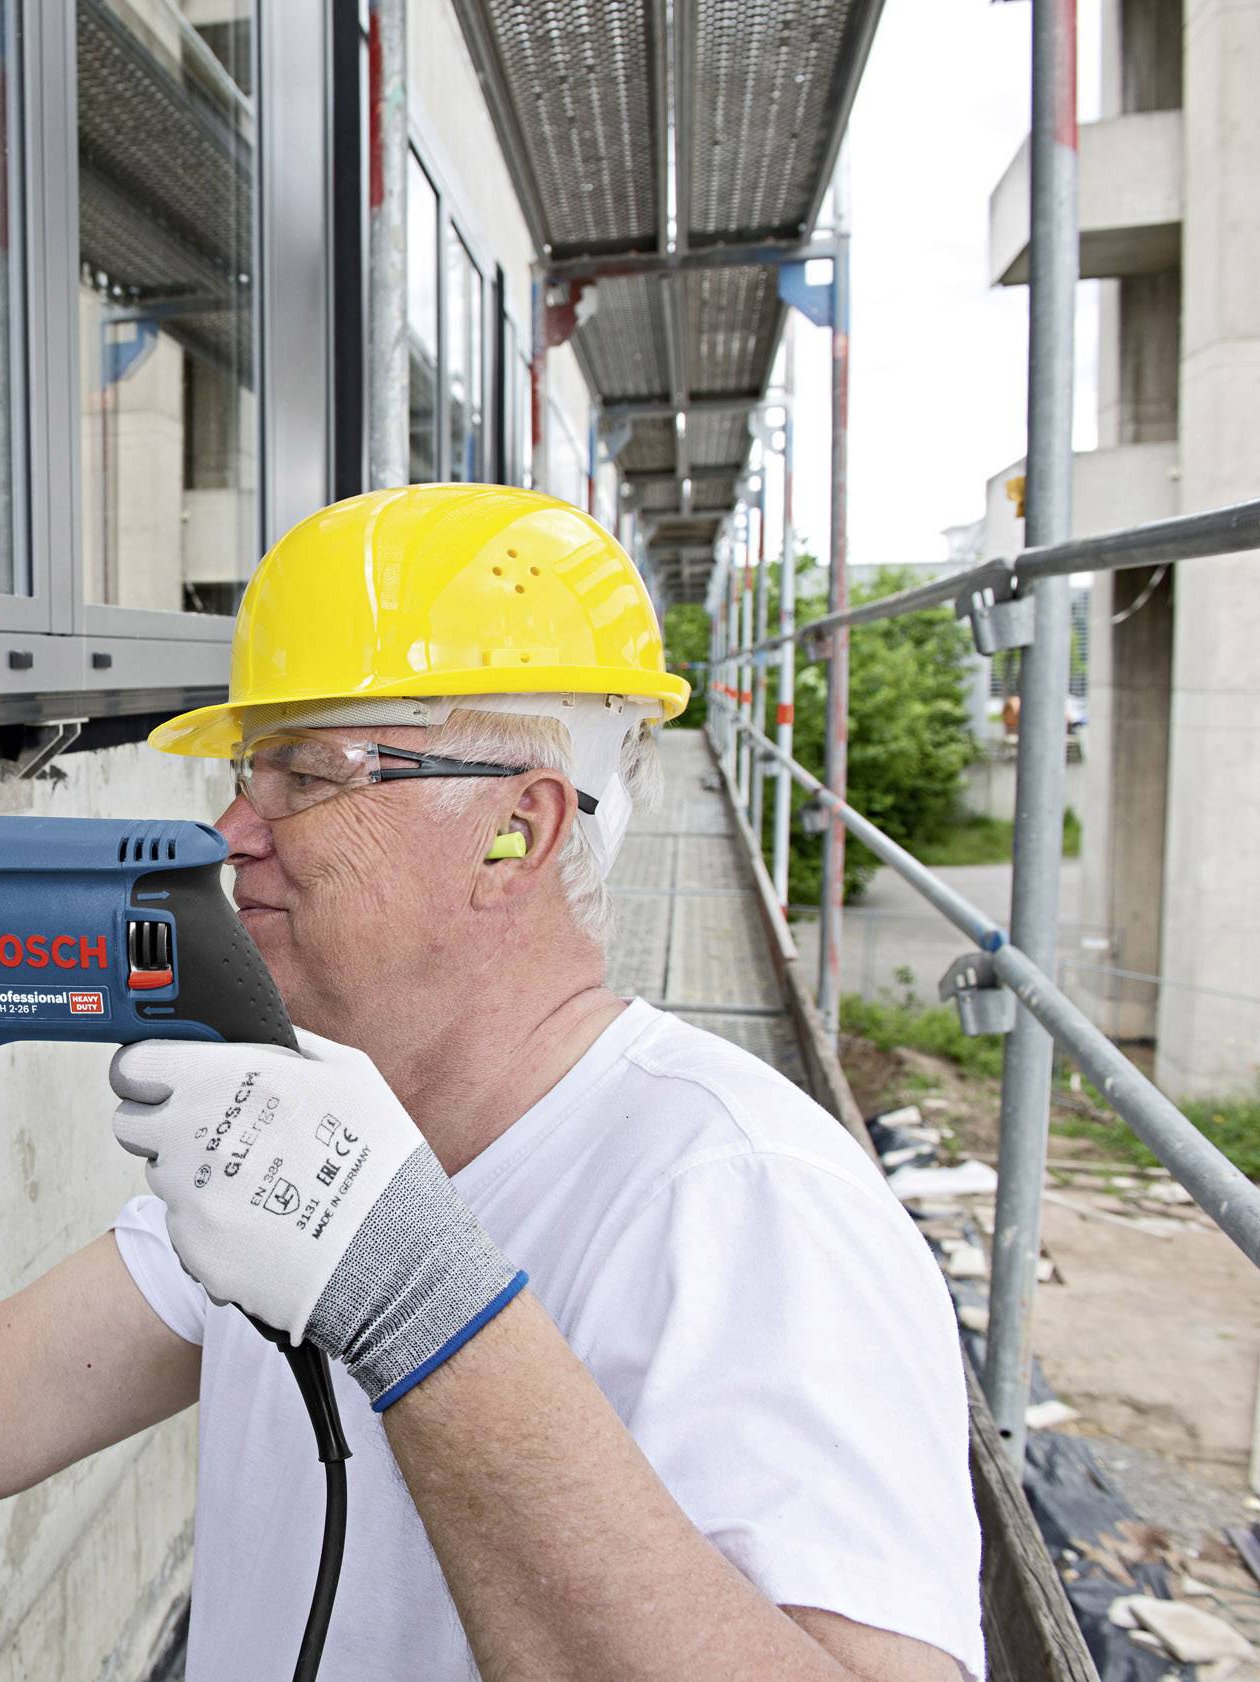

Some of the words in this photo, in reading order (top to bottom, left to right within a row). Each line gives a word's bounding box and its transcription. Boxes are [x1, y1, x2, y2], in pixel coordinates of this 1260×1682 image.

[9, 1004, 29, 1013] 2-26
[32, 1004, 38, 1013] F
[72, 995, 98, 1003] HEAVY
[76, 1003, 98, 1011] DUTY
[206, 1071, 261, 1152] BOSCH
[250, 1186, 267, 1207] EN
[311, 1210, 334, 1240] MADE
[330, 1197, 342, 1208] IN
[340, 1144, 372, 1195] GERMANY
[296, 1198, 320, 1230] 3131
